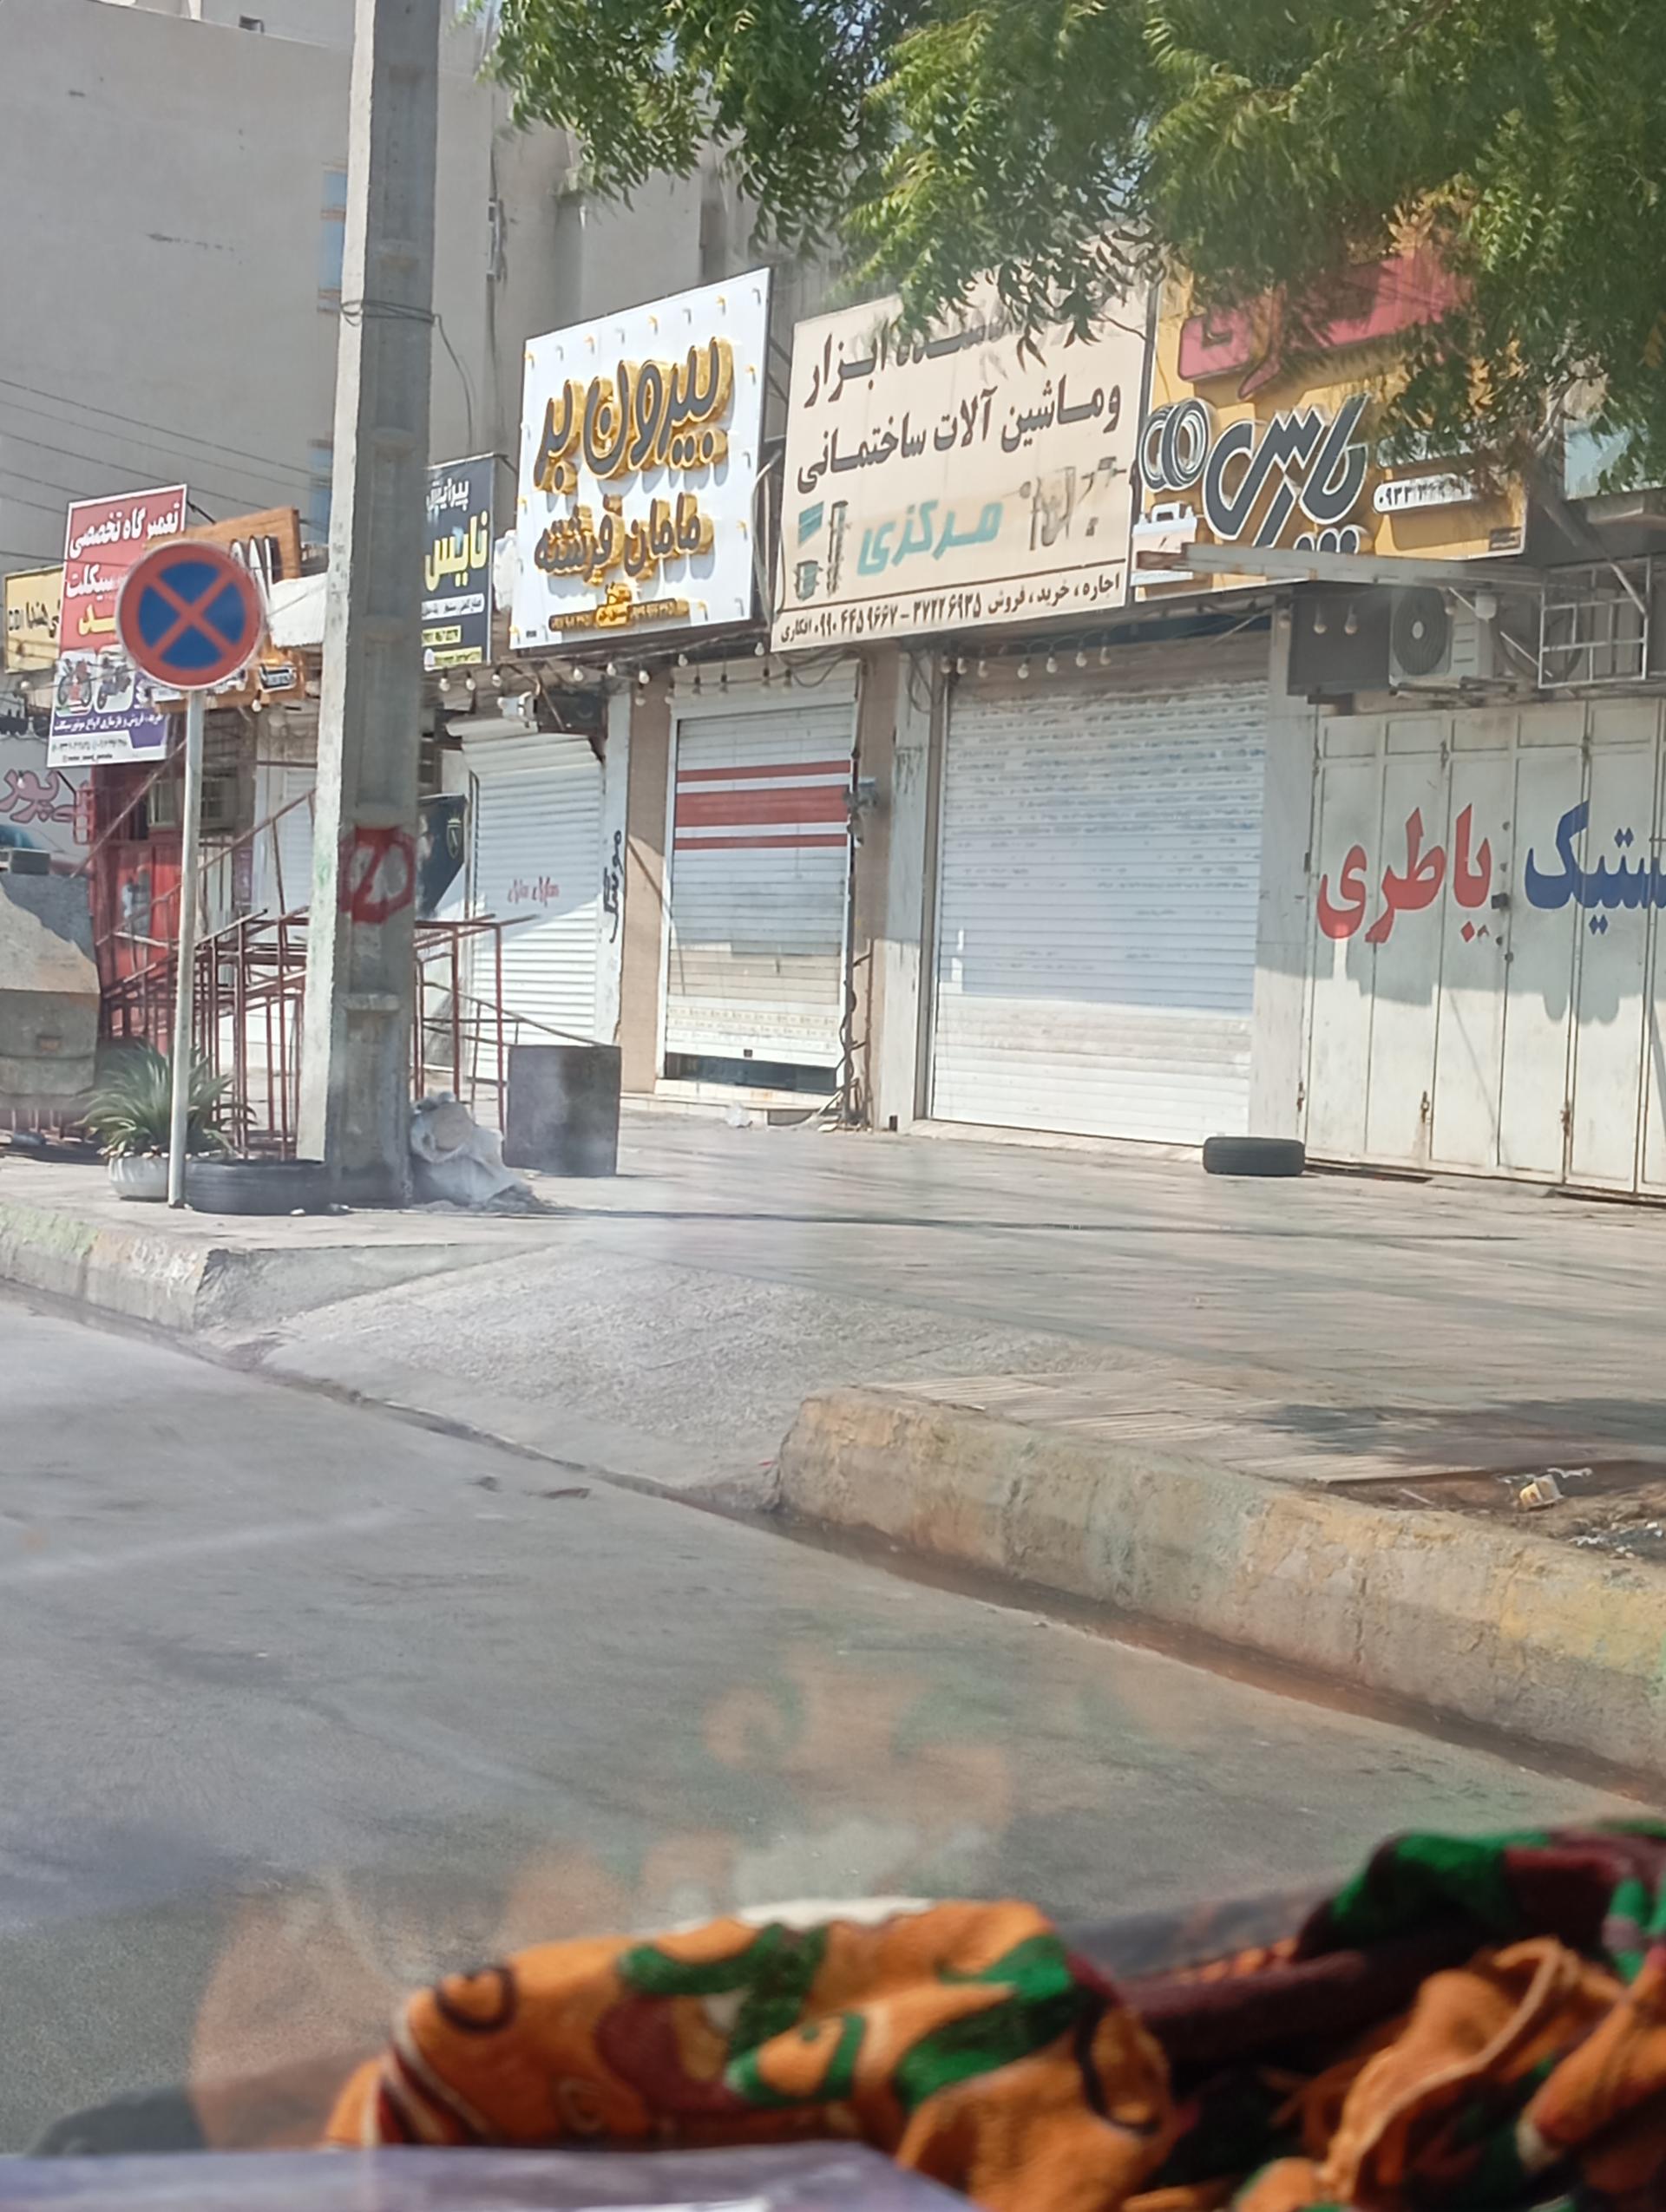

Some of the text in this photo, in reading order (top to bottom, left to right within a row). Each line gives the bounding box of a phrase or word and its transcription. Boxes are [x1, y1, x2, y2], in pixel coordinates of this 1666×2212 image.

[803, 317, 888, 408] ابزار
[533, 335, 736, 496] بیرون بر
[797, 412, 926, 494] ساختمانی
[934, 386, 998, 452] آلات
[423, 510, 489, 592] نایس
[533, 491, 714, 586] مامان فرشته
[856, 500, 1004, 577] مرکزی
[987, 585, 1026, 614] فروش
